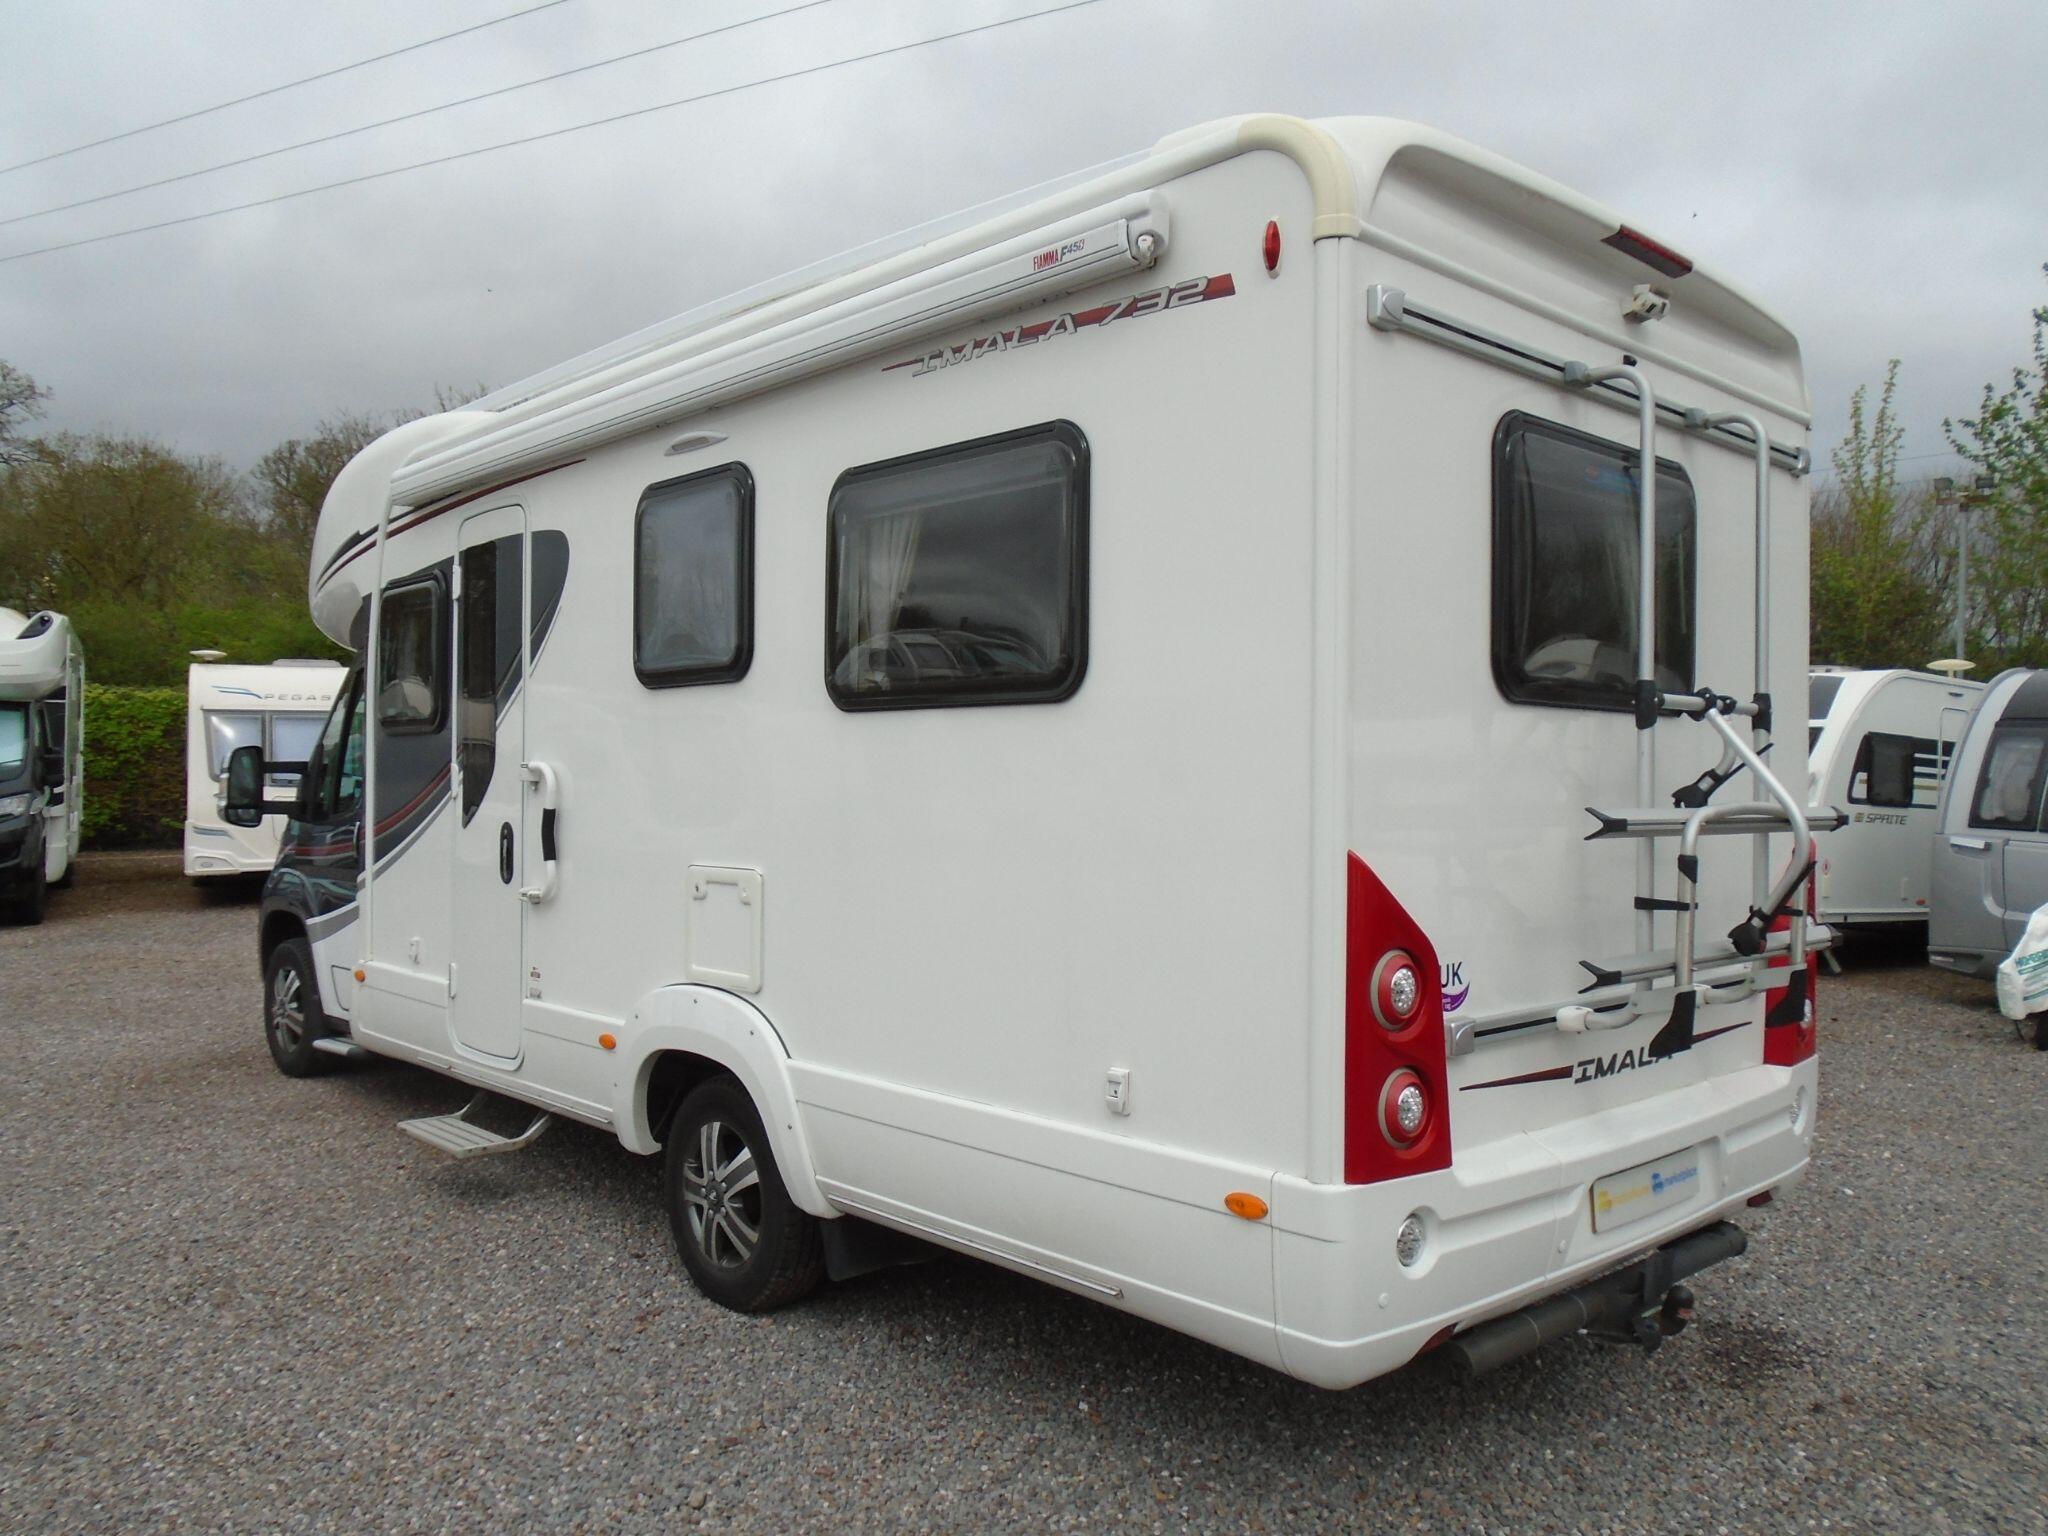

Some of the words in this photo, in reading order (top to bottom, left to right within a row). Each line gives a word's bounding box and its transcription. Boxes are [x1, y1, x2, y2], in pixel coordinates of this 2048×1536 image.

[1033, 249, 1059, 271] FIAMMA
[912, 312, 1078, 377] IMALA
[1098, 275, 1210, 327] 732
[1866, 813, 1907, 825] SPRITE
[1575, 1046, 1673, 1084] IMAL
